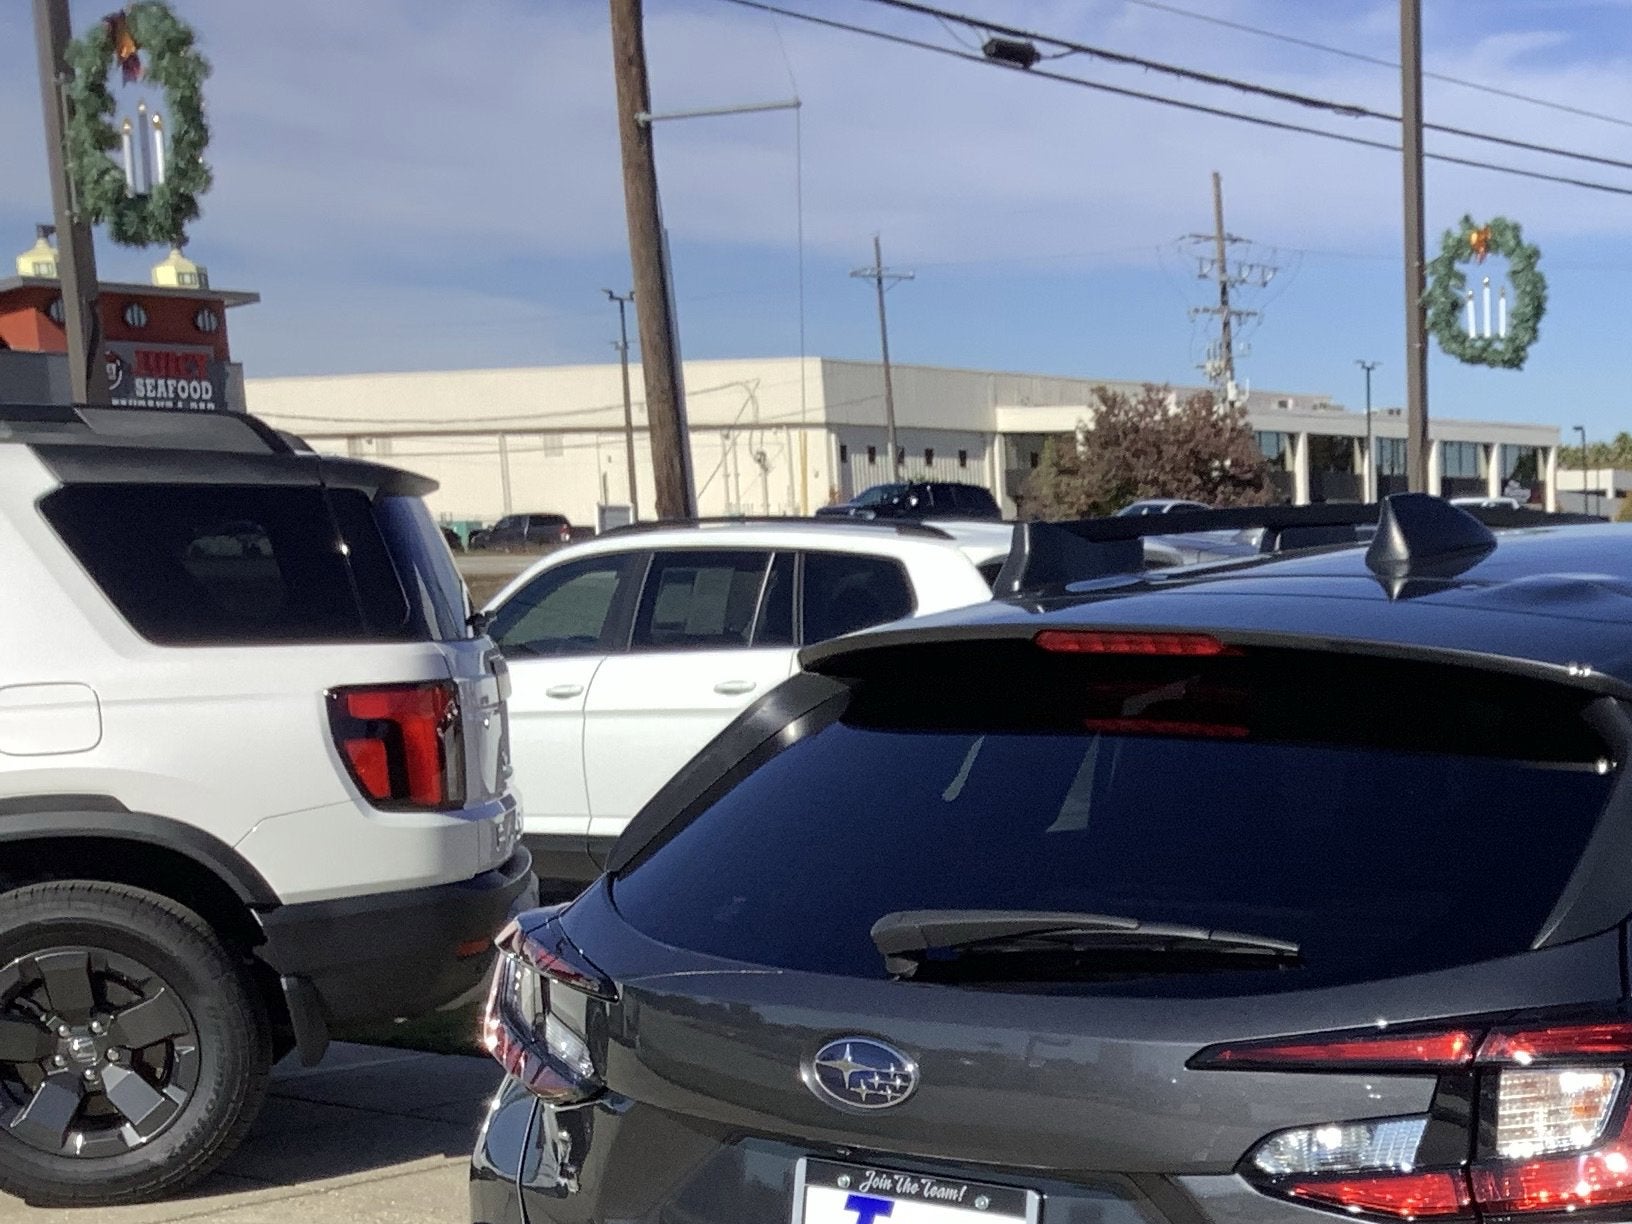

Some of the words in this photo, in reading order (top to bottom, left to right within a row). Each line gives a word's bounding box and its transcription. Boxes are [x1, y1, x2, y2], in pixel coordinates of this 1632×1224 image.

[135, 377, 213, 400] SEAFOOD
[859, 1170, 893, 1193] Join
[894, 1174, 920, 1194] The
[921, 1178, 968, 1202] Team!
